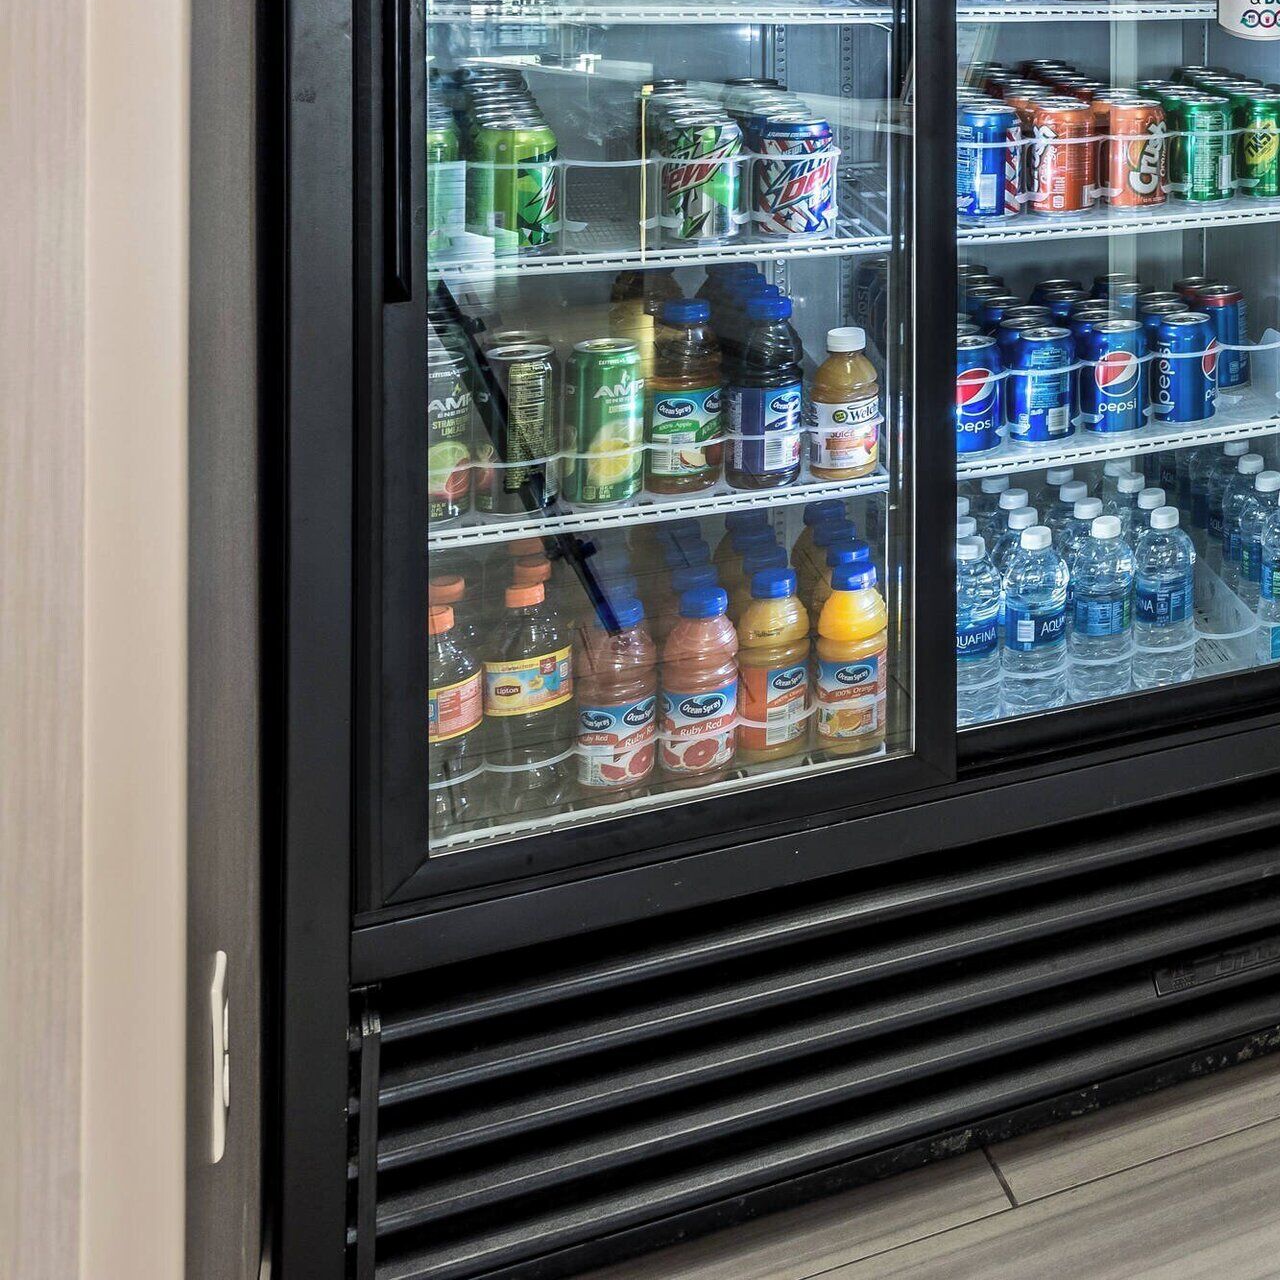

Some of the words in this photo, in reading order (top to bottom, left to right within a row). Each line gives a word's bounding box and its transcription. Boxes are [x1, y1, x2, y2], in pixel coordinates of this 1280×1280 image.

[1158, 340, 1175, 404] pepsi
[658, 404, 676, 417] Ocean
[676, 404, 693, 418] Spray
[1098, 399, 1138, 416] pepsi
[774, 677, 790, 688] Ocean
[837, 672, 853, 682] Ocean
[853, 671, 868, 683] Spray
[496, 686, 521, 698] Lipton
[835, 689, 851, 698] 100%
[853, 685, 875, 696] Orange
[681, 703, 702, 715] Ocean
[702, 699, 722, 715] Spray
[626, 709, 645, 722] Ocean
[681, 725, 705, 738] Ruby
[705, 719, 723, 731] Red
[625, 731, 647, 748] Ruby
